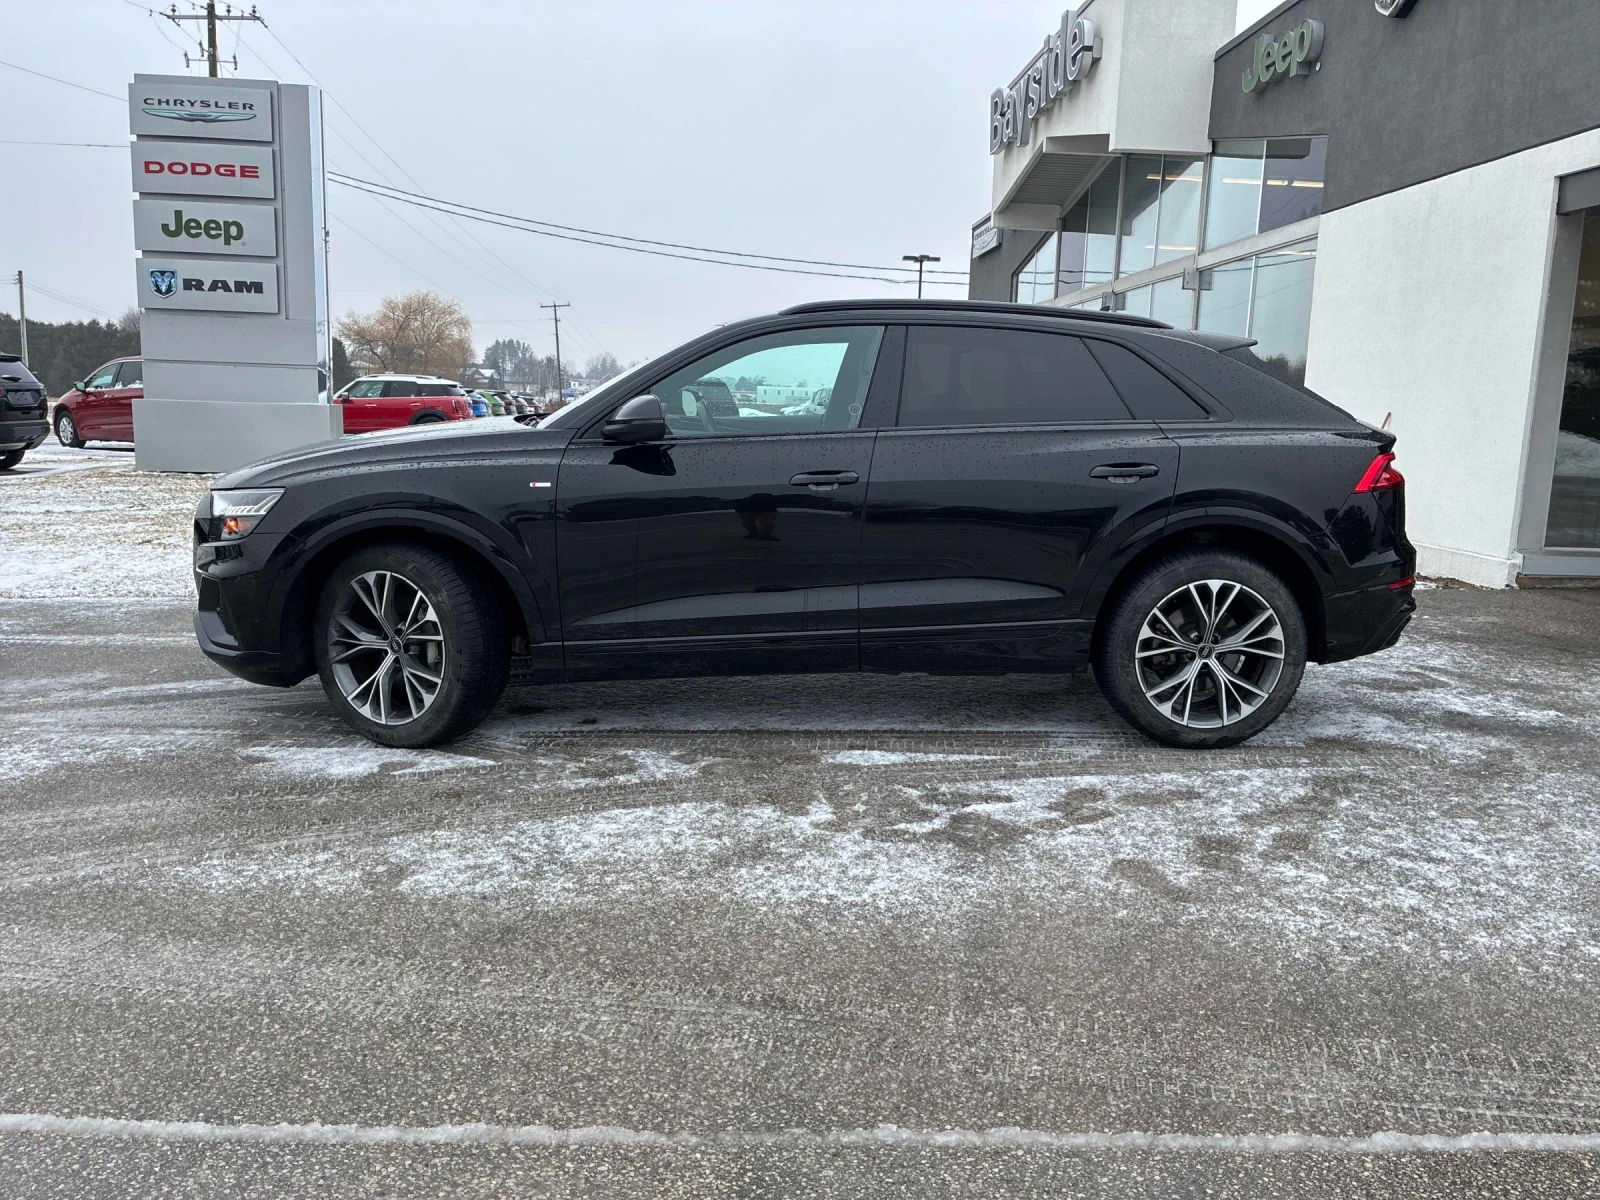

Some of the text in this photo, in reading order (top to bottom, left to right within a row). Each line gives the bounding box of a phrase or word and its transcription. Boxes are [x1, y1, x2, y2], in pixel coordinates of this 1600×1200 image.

[1242, 19, 1325, 93] Jeep
[990, 9, 1095, 156] Bayside
[143, 97, 255, 111] CHRYSLER
[143, 160, 260, 179] DODGE
[161, 209, 244, 246] Jeep
[182, 277, 264, 295] RAM
